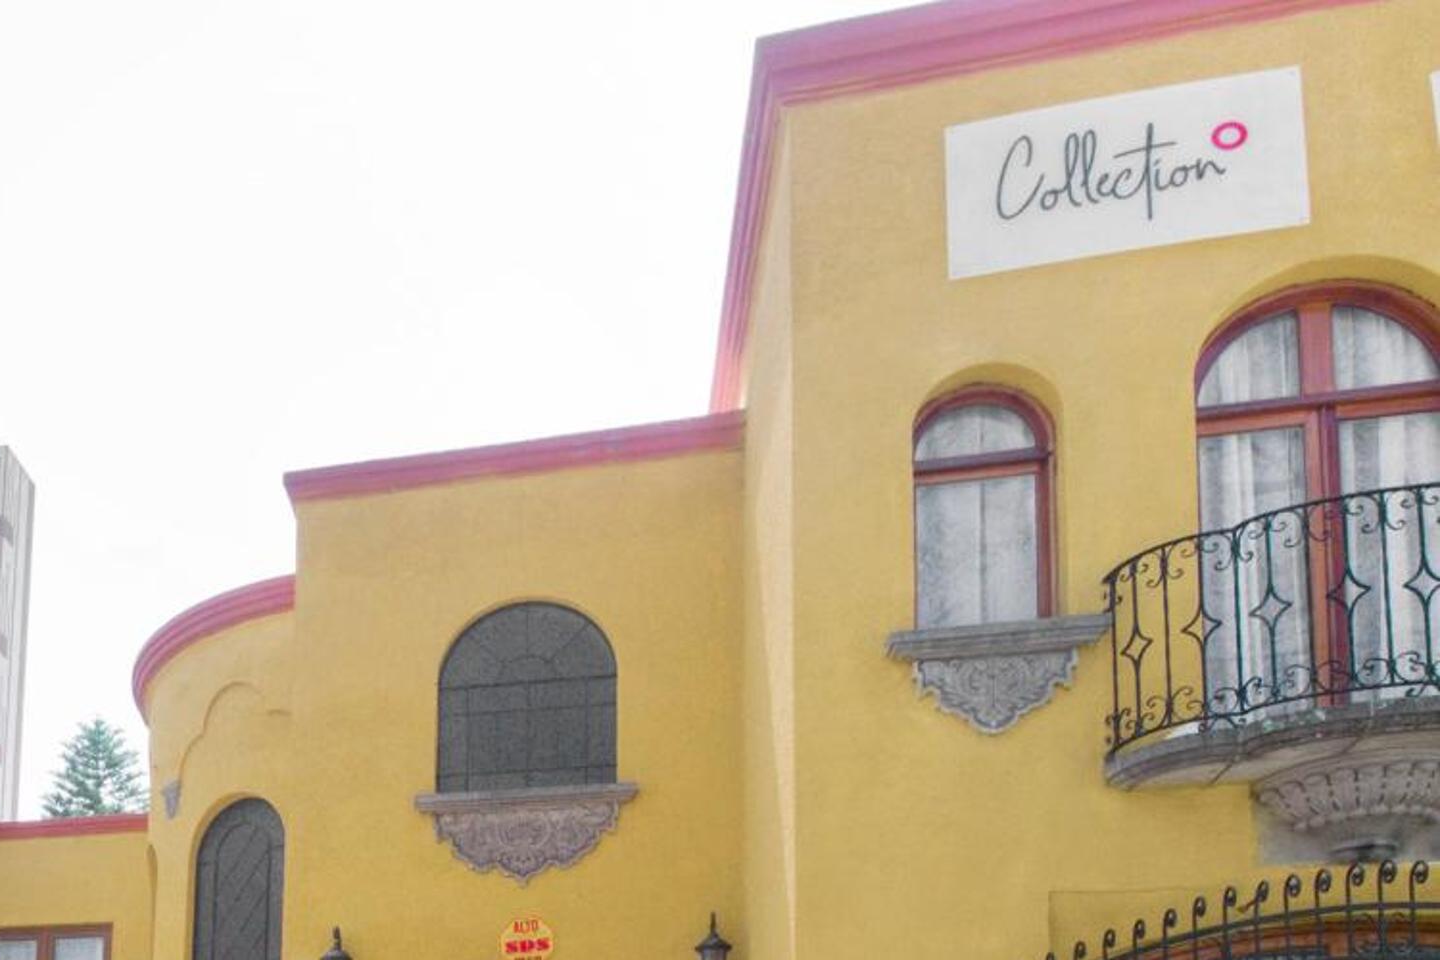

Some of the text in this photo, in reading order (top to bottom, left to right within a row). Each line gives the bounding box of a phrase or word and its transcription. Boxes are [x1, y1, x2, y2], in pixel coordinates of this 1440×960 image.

[996, 122, 1226, 221] Collection
[513, 919, 539, 933] ALTO
[505, 938, 550, 953] SDS
